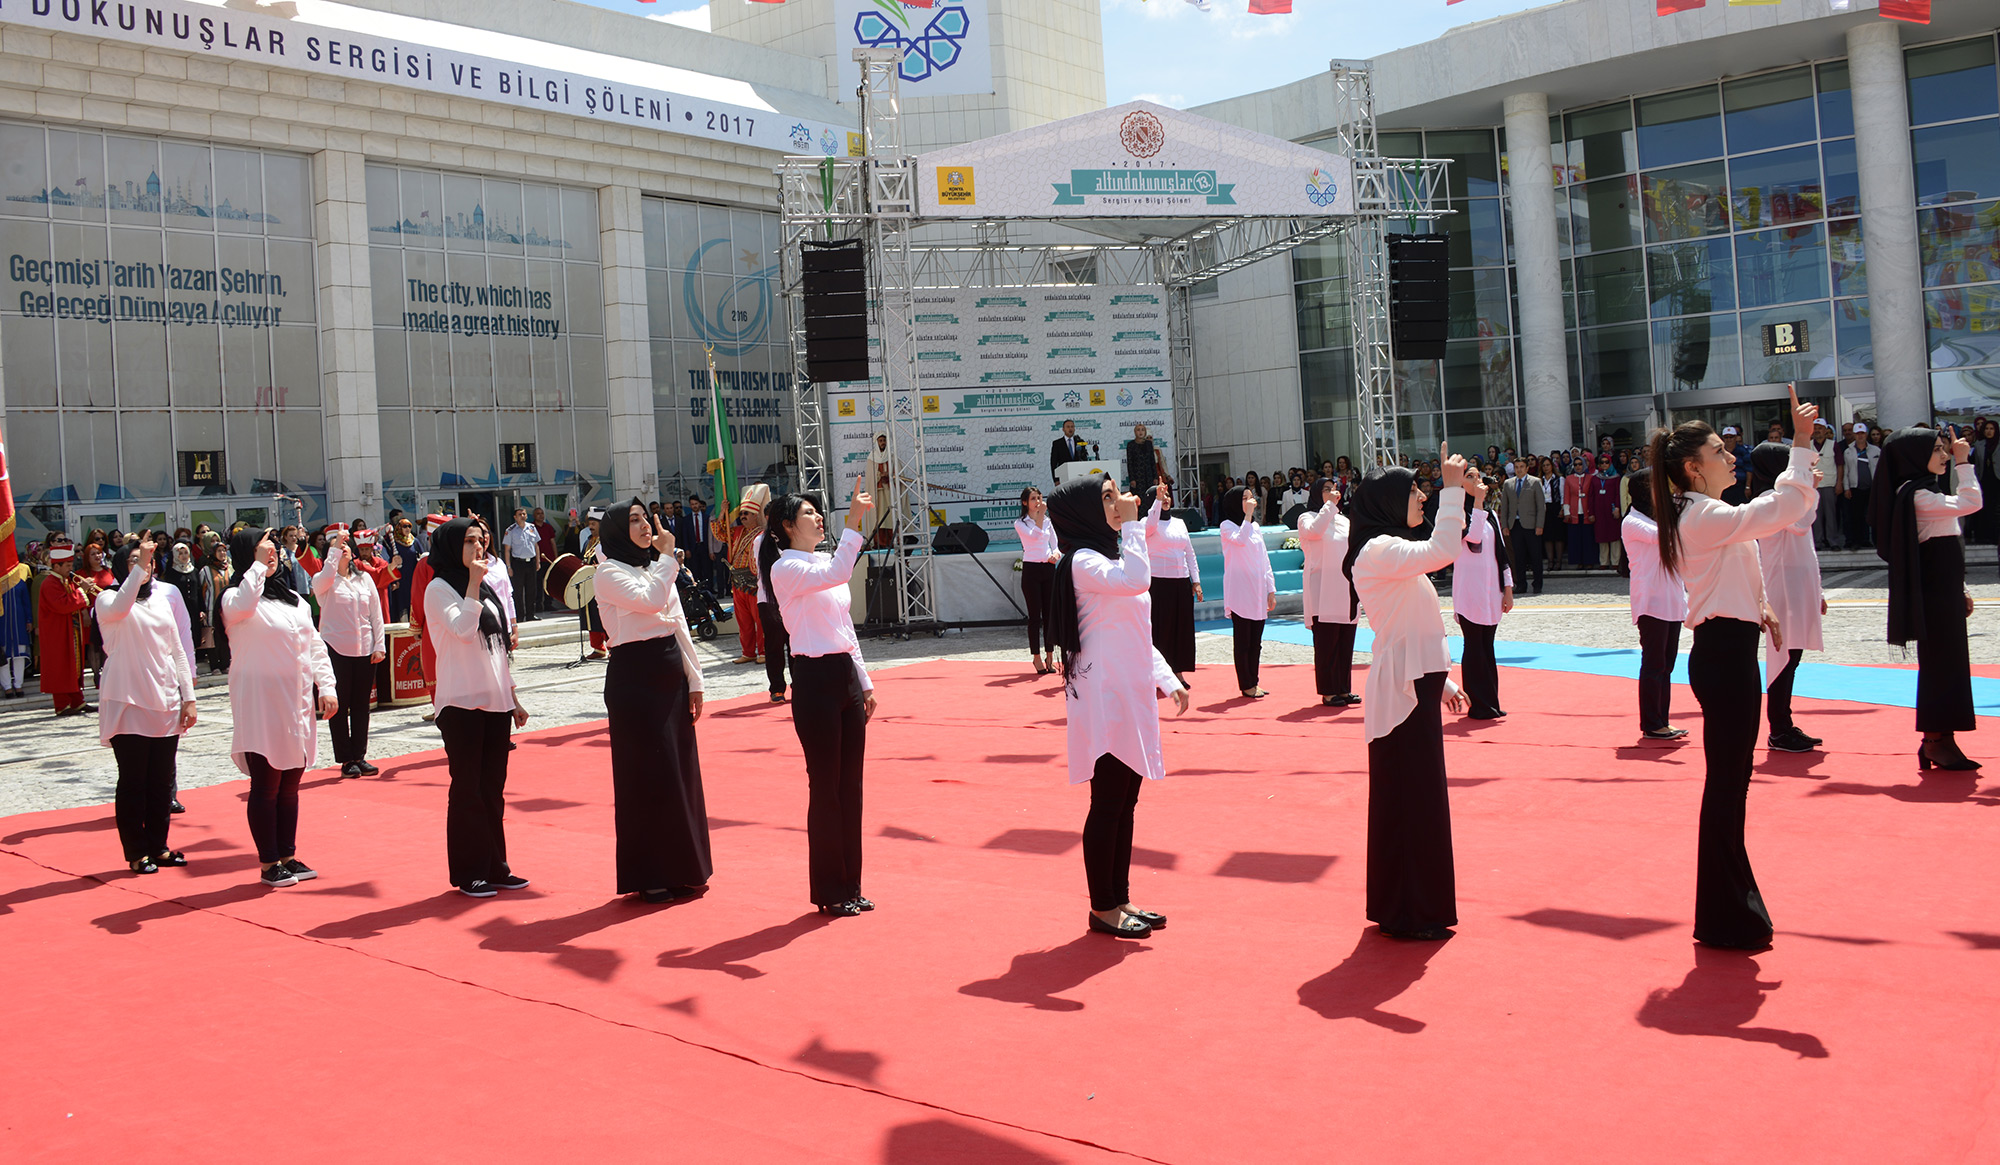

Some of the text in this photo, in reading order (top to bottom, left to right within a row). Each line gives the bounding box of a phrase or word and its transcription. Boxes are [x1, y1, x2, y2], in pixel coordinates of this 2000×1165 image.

[32, 0, 755, 137] DOKUNUŞLAR SERGİSİ VE BİLGİ ŞÖLENİ 2017
[1103, 197, 1131, 205] Sergisi
[1145, 197, 1164, 205] Bilgi
[10, 254, 100, 288] Geçmişi
[104, 260, 155, 288] Tarih
[158, 263, 216, 292] Yazan
[408, 279, 552, 310] The city, which has
[19, 291, 282, 329] Geleceği Dünyaya Açılıyor
[731, 310, 748, 322] 2016
[403, 311, 560, 340] made a great history
[1775, 323, 1795, 346] B
[1775, 346, 1797, 354] BLOK
[717, 371, 770, 391] TOURISM
[690, 398, 706, 417] OF
[736, 398, 781, 417] ISLAMIC
[692, 424, 781, 445] WOD KONYA
[194, 453, 211, 473] H
